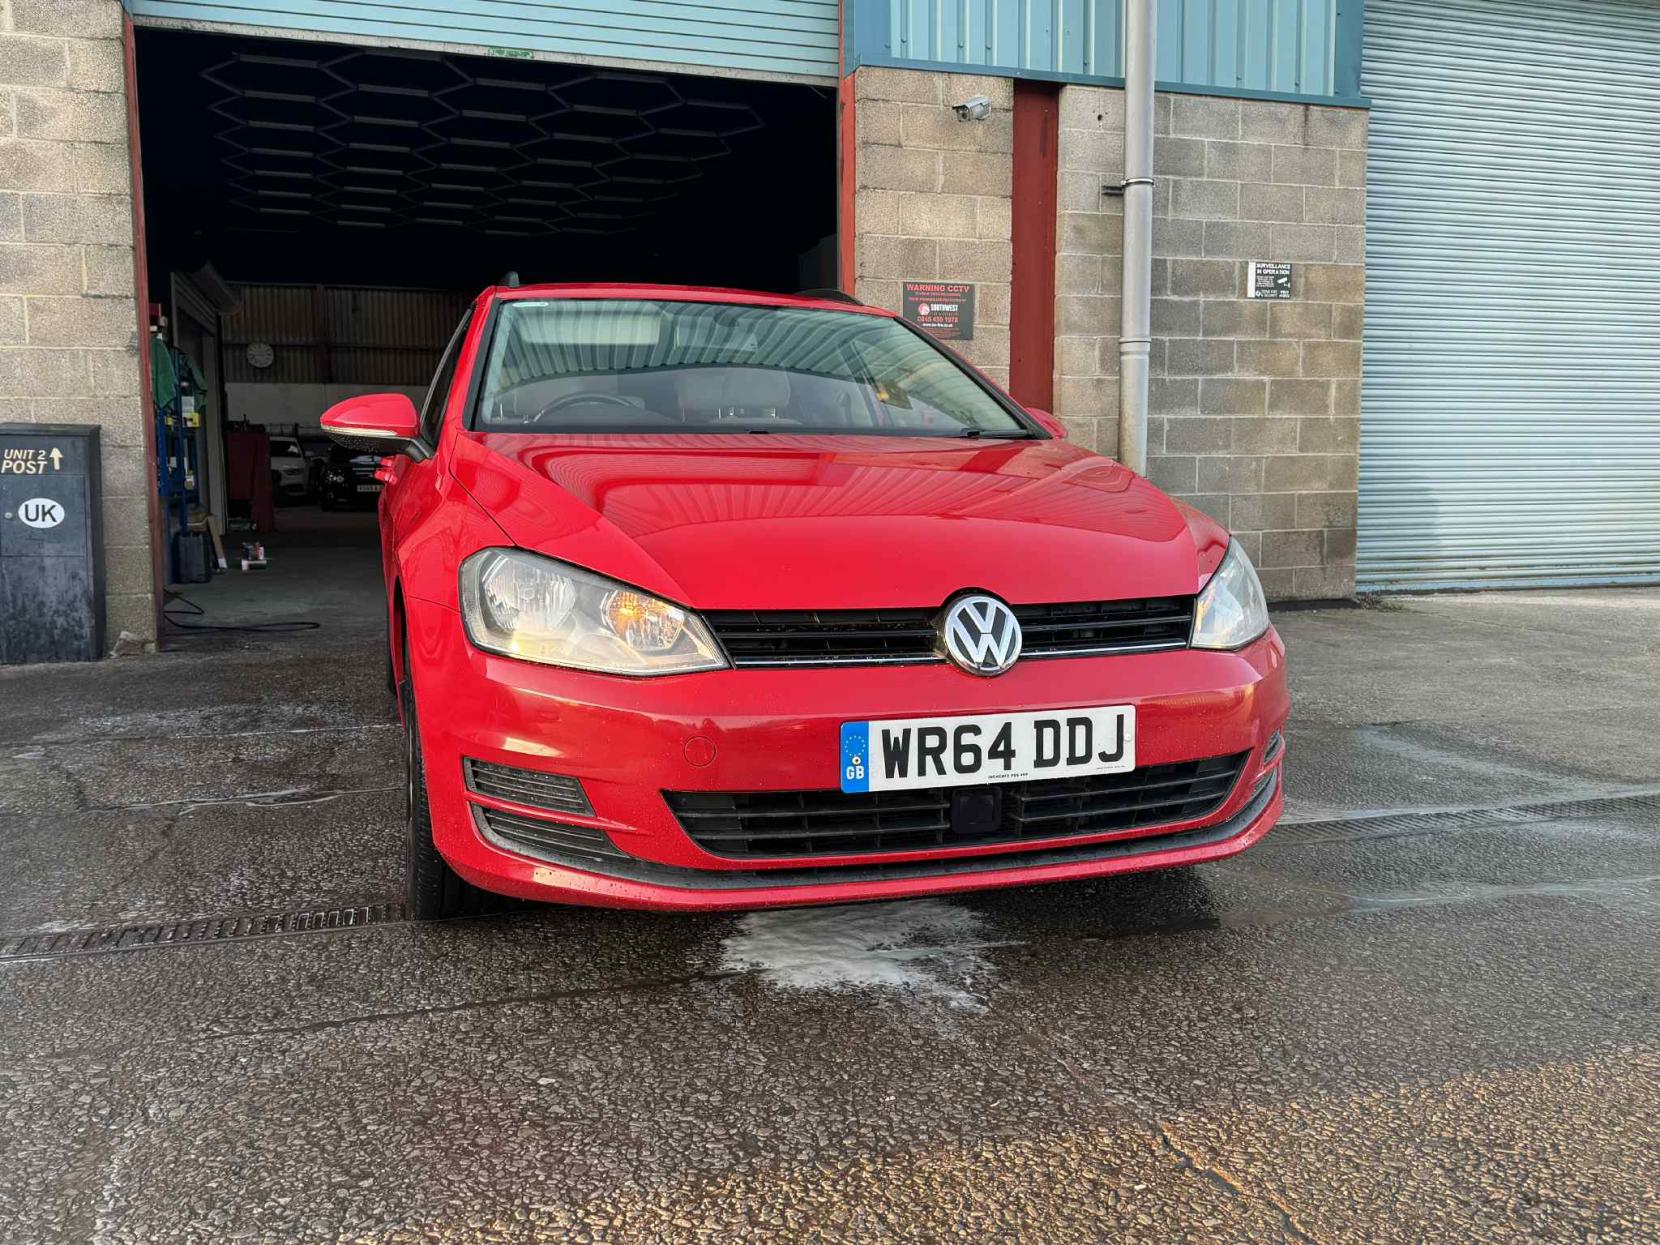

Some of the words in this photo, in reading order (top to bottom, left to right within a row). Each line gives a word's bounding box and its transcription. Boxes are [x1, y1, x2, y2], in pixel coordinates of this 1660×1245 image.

[906, 284, 945, 292] WARNING
[947, 285, 970, 293] CCTV
[3, 449, 36, 460] UNIT
[37, 449, 47, 460] 2
[0, 460, 48, 475] POST
[24, 503, 58, 523] UK
[950, 599, 1016, 668] VW
[881, 721, 1017, 779] WR64
[1033, 713, 1126, 769] DDJ
[846, 765, 865, 780] GB
